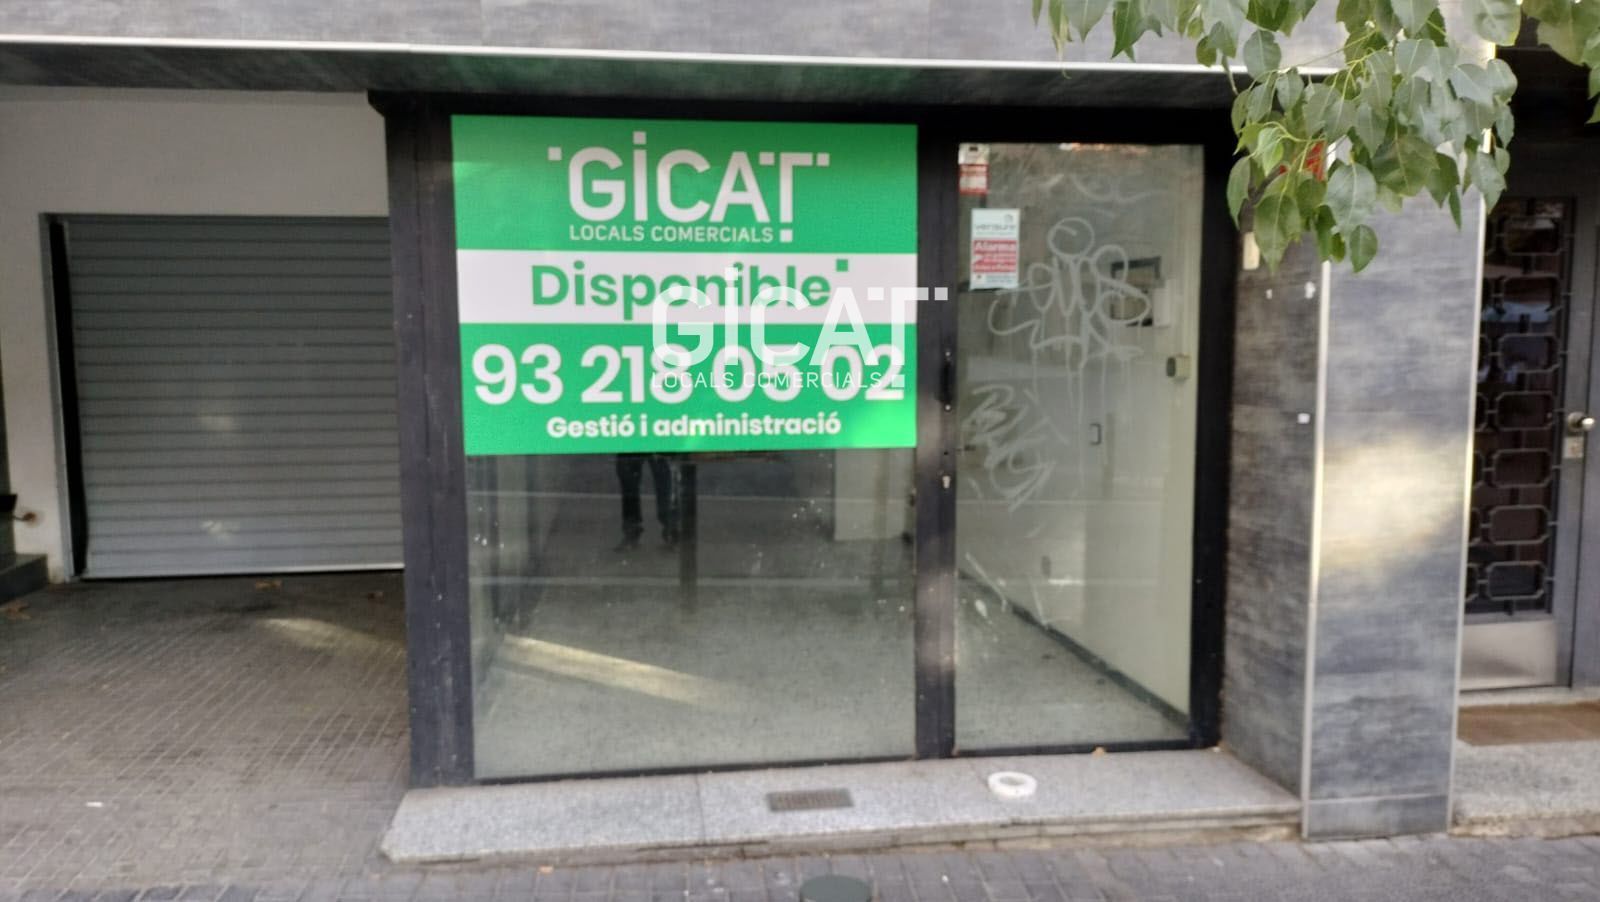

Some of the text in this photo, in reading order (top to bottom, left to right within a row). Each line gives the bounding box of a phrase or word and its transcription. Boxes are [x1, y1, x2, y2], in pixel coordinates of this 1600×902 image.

[569, 225, 774, 243] LOCALS COMERCIALS
[530, 261, 832, 320] Disponible
[472, 344, 564, 405] 93
[580, 343, 693, 404] 218
[822, 344, 905, 402] 02
[546, 412, 841, 438] Gestió i administració
